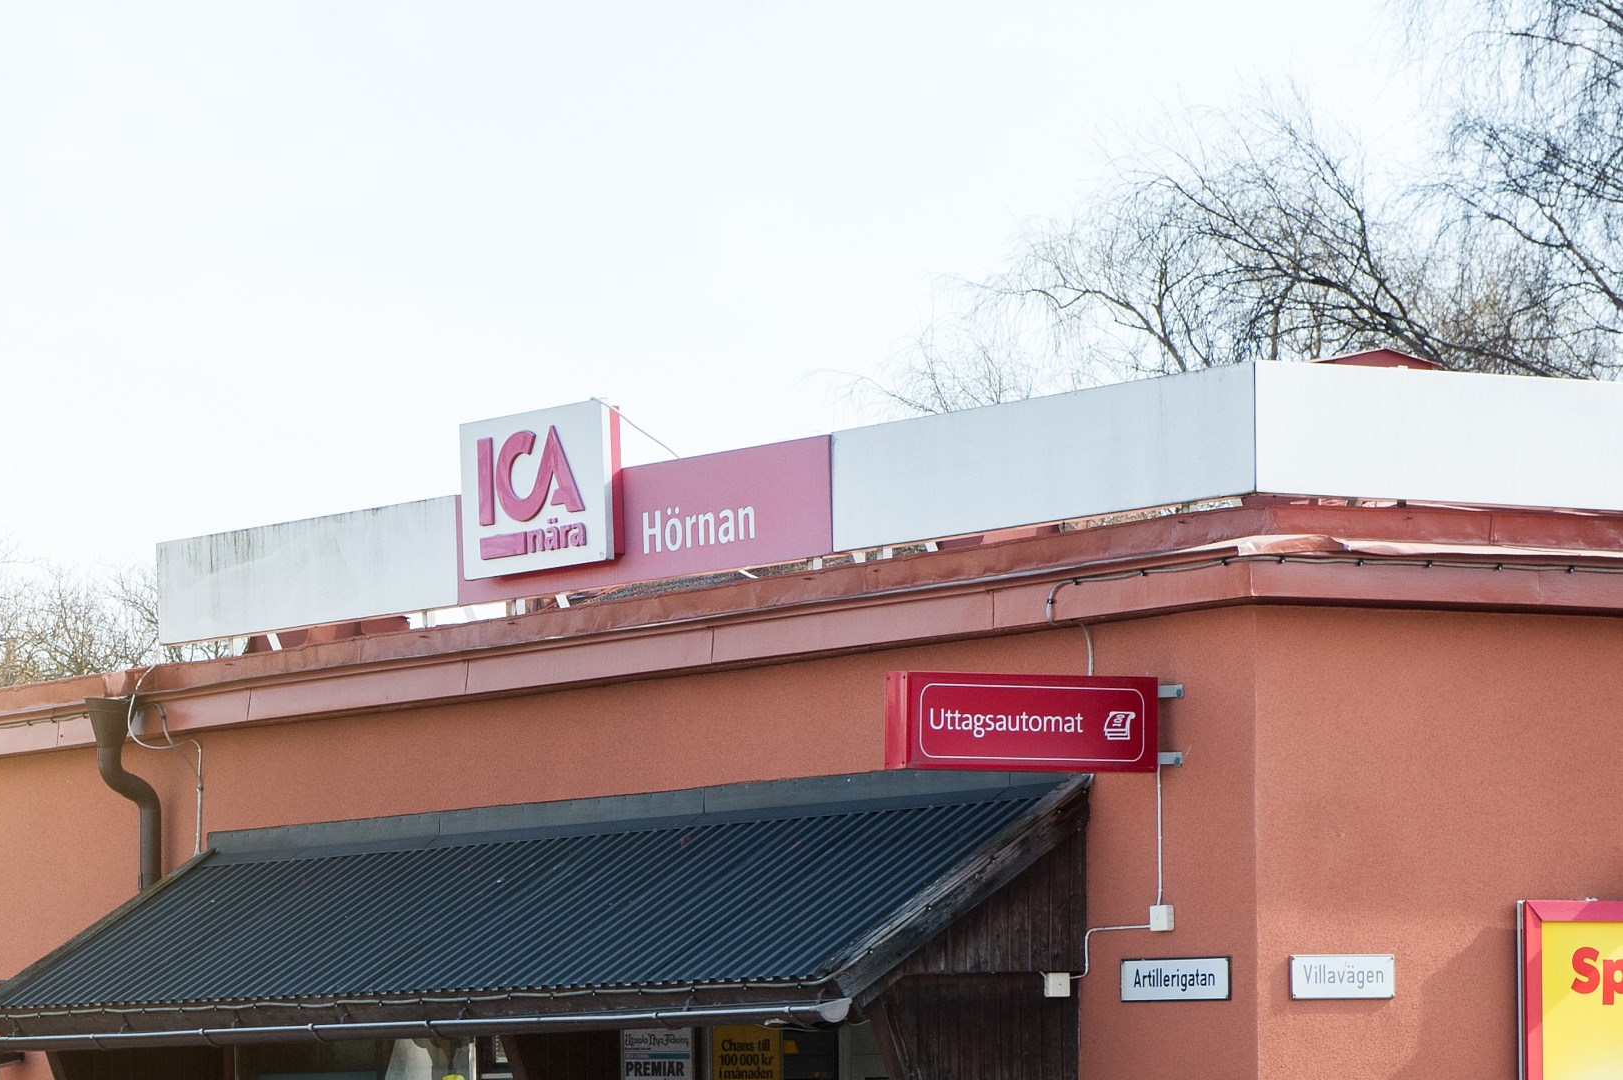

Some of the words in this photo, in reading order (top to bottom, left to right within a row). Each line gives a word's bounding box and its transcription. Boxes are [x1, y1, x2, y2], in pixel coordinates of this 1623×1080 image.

[477, 425, 585, 526] ICA
[526, 518, 587, 554] nära
[641, 505, 756, 554] Hörnan
[929, 707, 1084, 738] Uttagsautomat
[1133, 968, 1216, 992] Artillerigatan
[1303, 964, 1385, 989] Villavägen
[721, 1039, 755, 1052] Chans
[757, 1038, 771, 1052] till
[625, 1060, 685, 1077] PREMIÄR
[719, 1054, 738, 1067] 100
[739, 1054, 759, 1067] 000
[761, 1053, 774, 1066] kr
[718, 1067, 722, 1079] i
[723, 1066, 774, 1080] månaden
